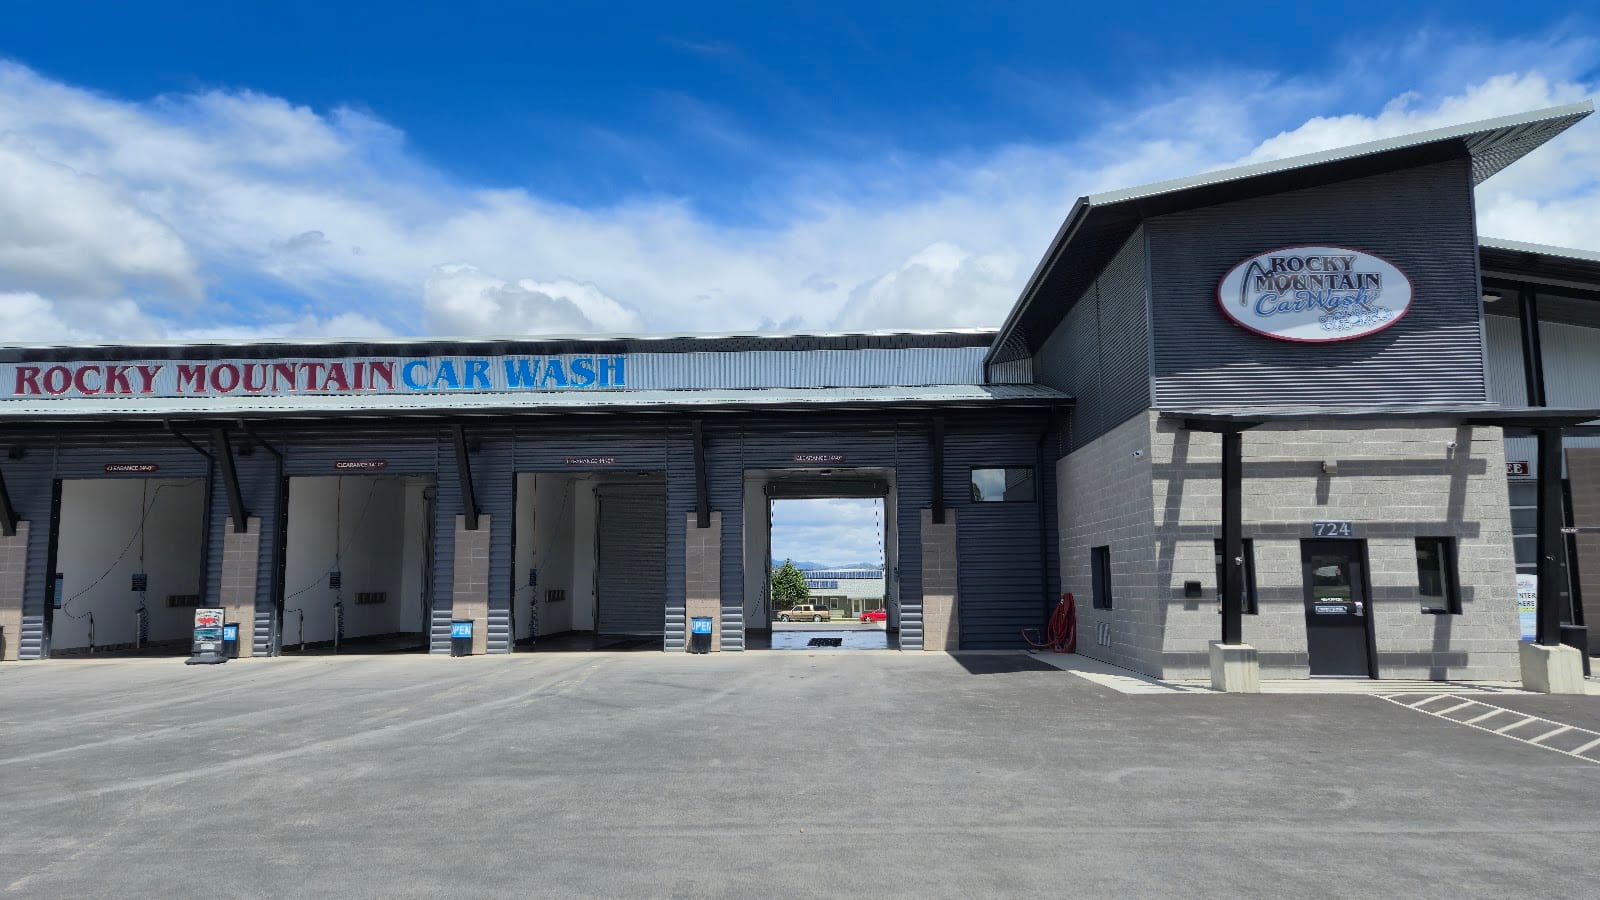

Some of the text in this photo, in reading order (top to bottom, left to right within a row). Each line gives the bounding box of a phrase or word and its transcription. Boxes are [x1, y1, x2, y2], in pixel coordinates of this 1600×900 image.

[1269, 255, 1356, 272] ROCKY
[1255, 273, 1382, 294] MOUNTAIN
[12, 357, 627, 396] ROCKY MOUNTAIN CAR WASH
[1315, 522, 1351, 536] 724
[451, 625, 471, 635] PEN
